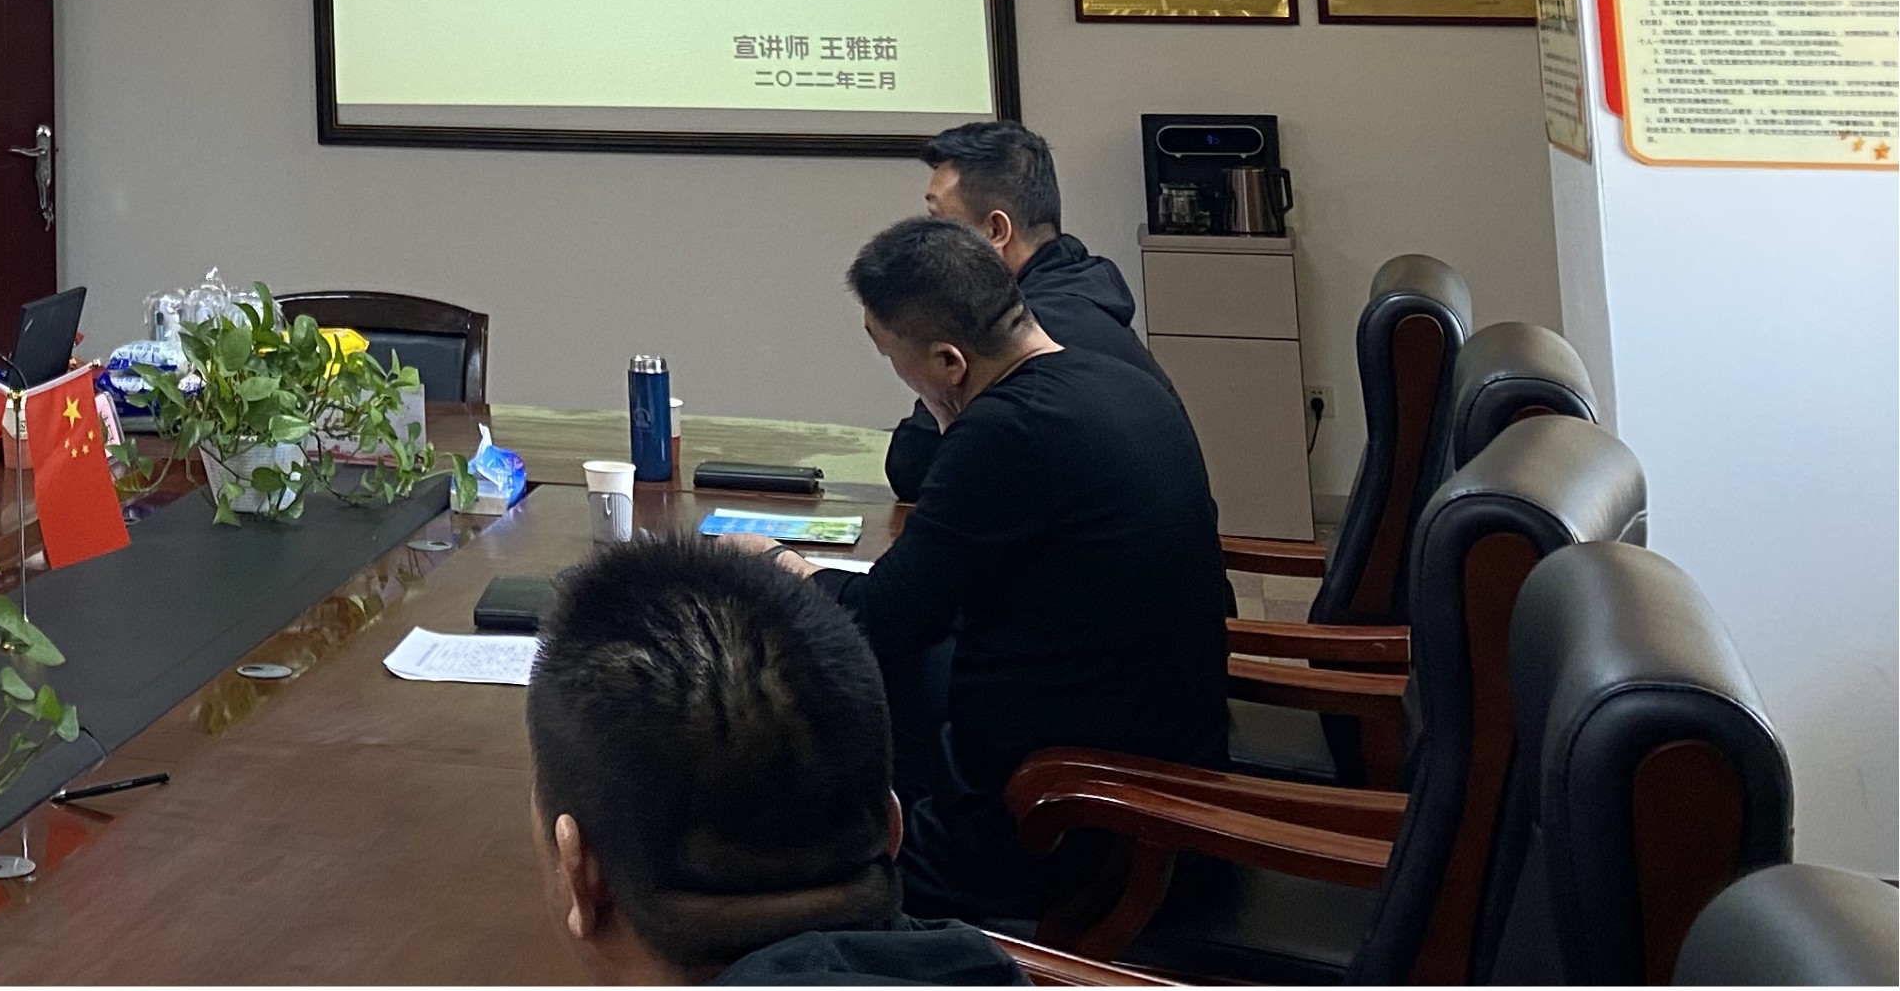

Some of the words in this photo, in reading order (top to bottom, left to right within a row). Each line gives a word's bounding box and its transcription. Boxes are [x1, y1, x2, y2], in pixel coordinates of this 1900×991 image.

[733, 35, 809, 60] 宣讲师
[820, 36, 898, 61] 王雅茹
